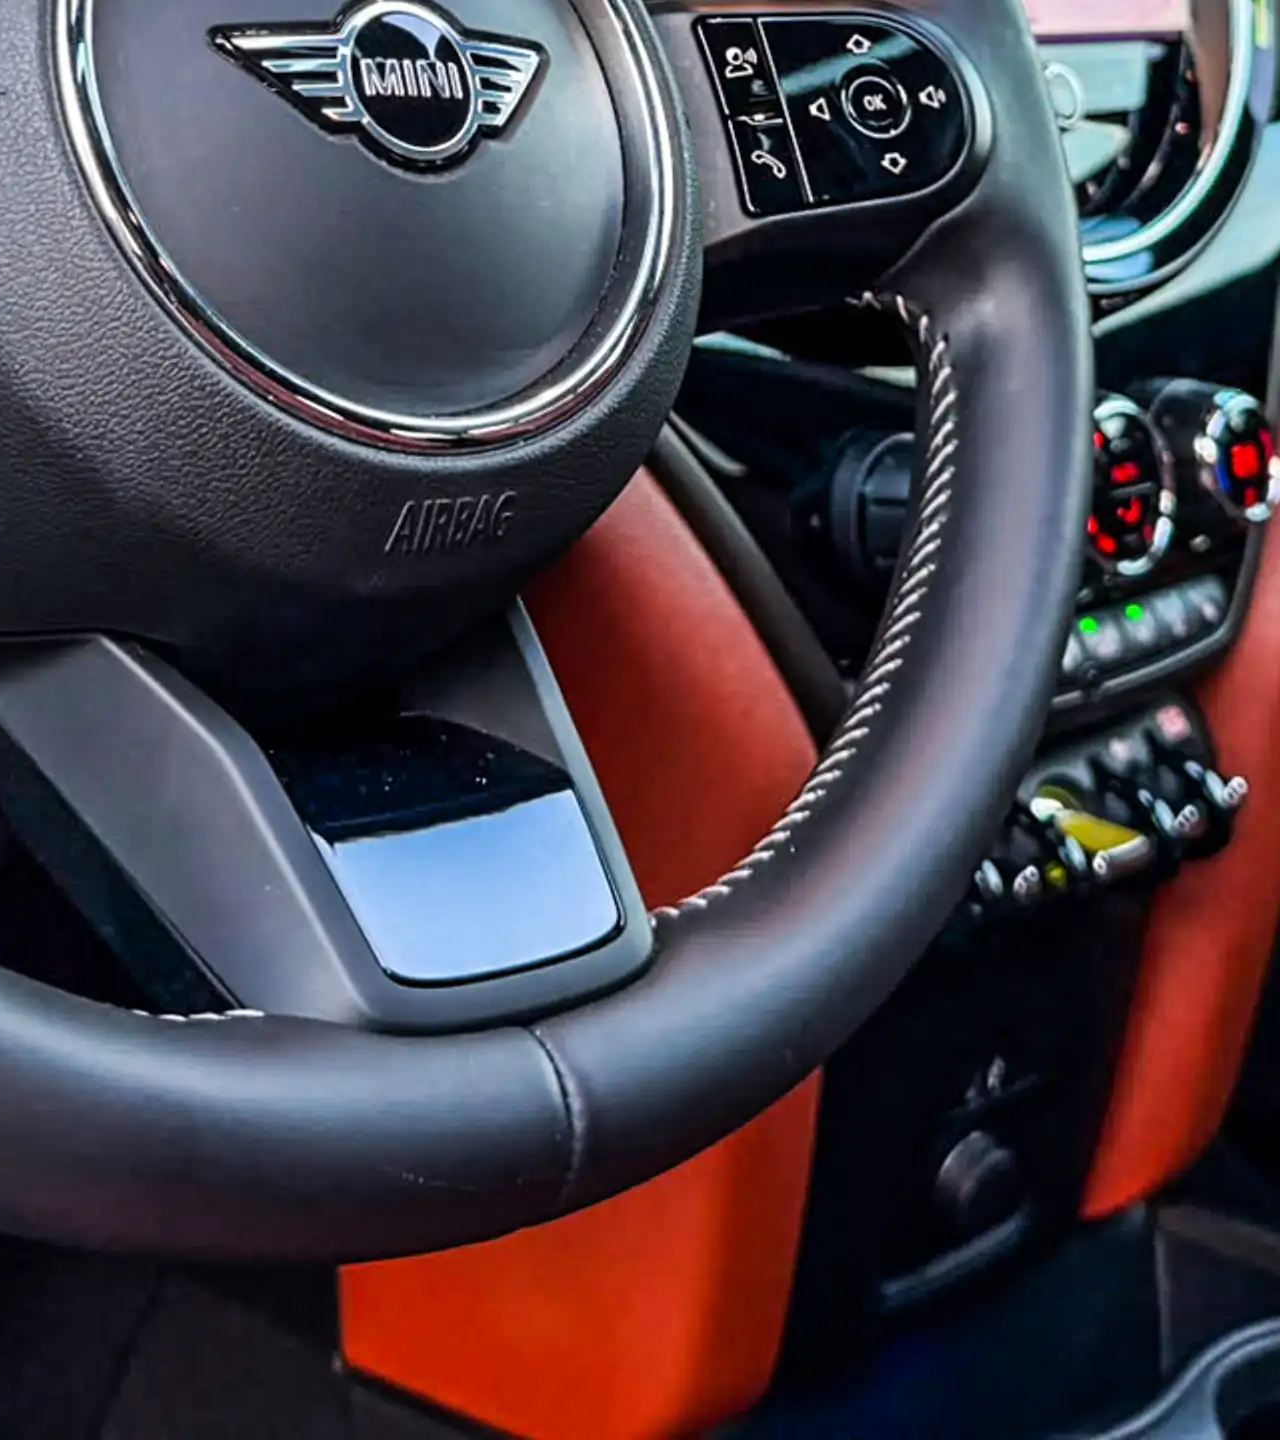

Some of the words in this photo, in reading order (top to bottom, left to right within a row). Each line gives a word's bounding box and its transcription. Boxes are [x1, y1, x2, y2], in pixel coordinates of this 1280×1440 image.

[360, 58, 463, 100] MINI
[863, 94, 887, 111] OK
[384, 490, 517, 553] AIRBAG
